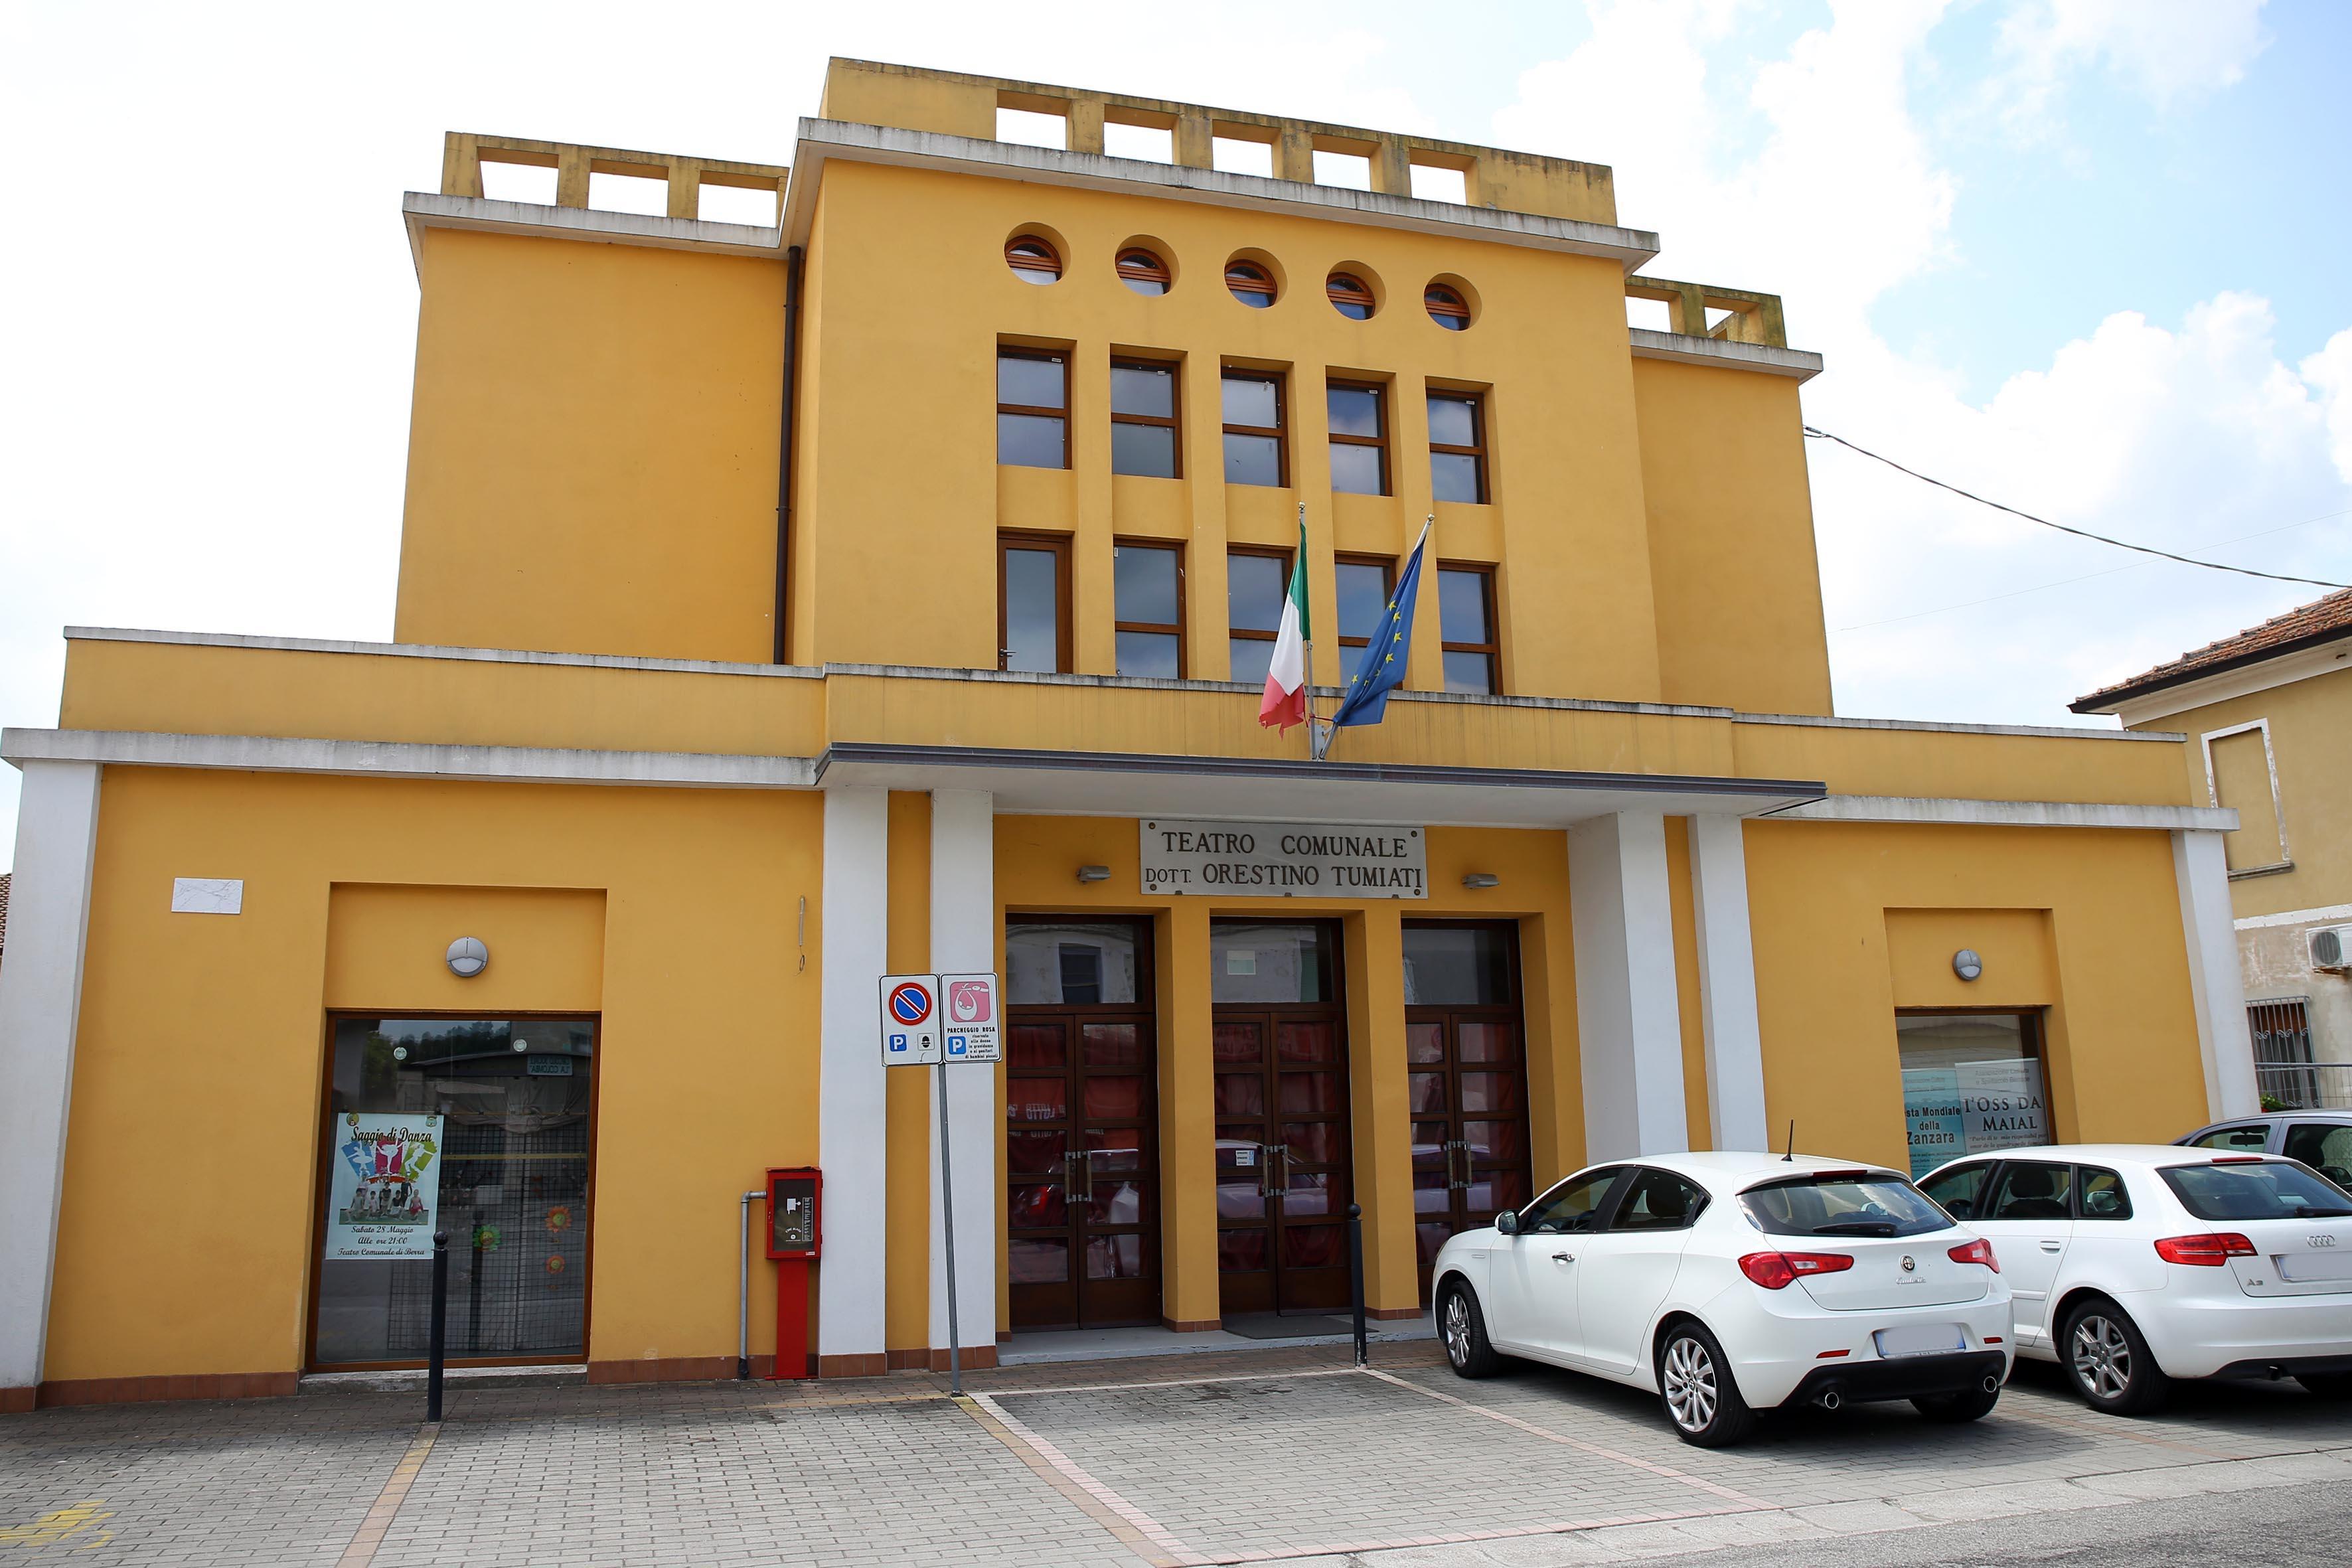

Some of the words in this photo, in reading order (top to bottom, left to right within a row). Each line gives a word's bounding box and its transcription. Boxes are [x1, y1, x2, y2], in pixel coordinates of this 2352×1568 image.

[1161, 831, 1255, 854] TEATRO
[1281, 834, 1408, 858] COMUNALE
[1145, 868, 1192, 884] DOTT.
[1202, 863, 1320, 886] ORESTINO
[1330, 866, 1423, 888] TUMIATI
[894, 1036, 904, 1050] P
[953, 1038, 963, 1052] P
[2017, 1095, 2041, 1110] DA
[1905, 1107, 1919, 1117] sta
[1922, 1105, 1961, 1117] Mondiale
[1919, 1120, 1940, 1131] della
[1982, 1116, 2038, 1132] MAIAL
[351, 1126, 384, 1146] Saggio
[386, 1127, 397, 1143] di
[399, 1127, 433, 1143] Danza
[1907, 1131, 1955, 1145] Zanzara
[387, 1225, 414, 1235] Maggio
